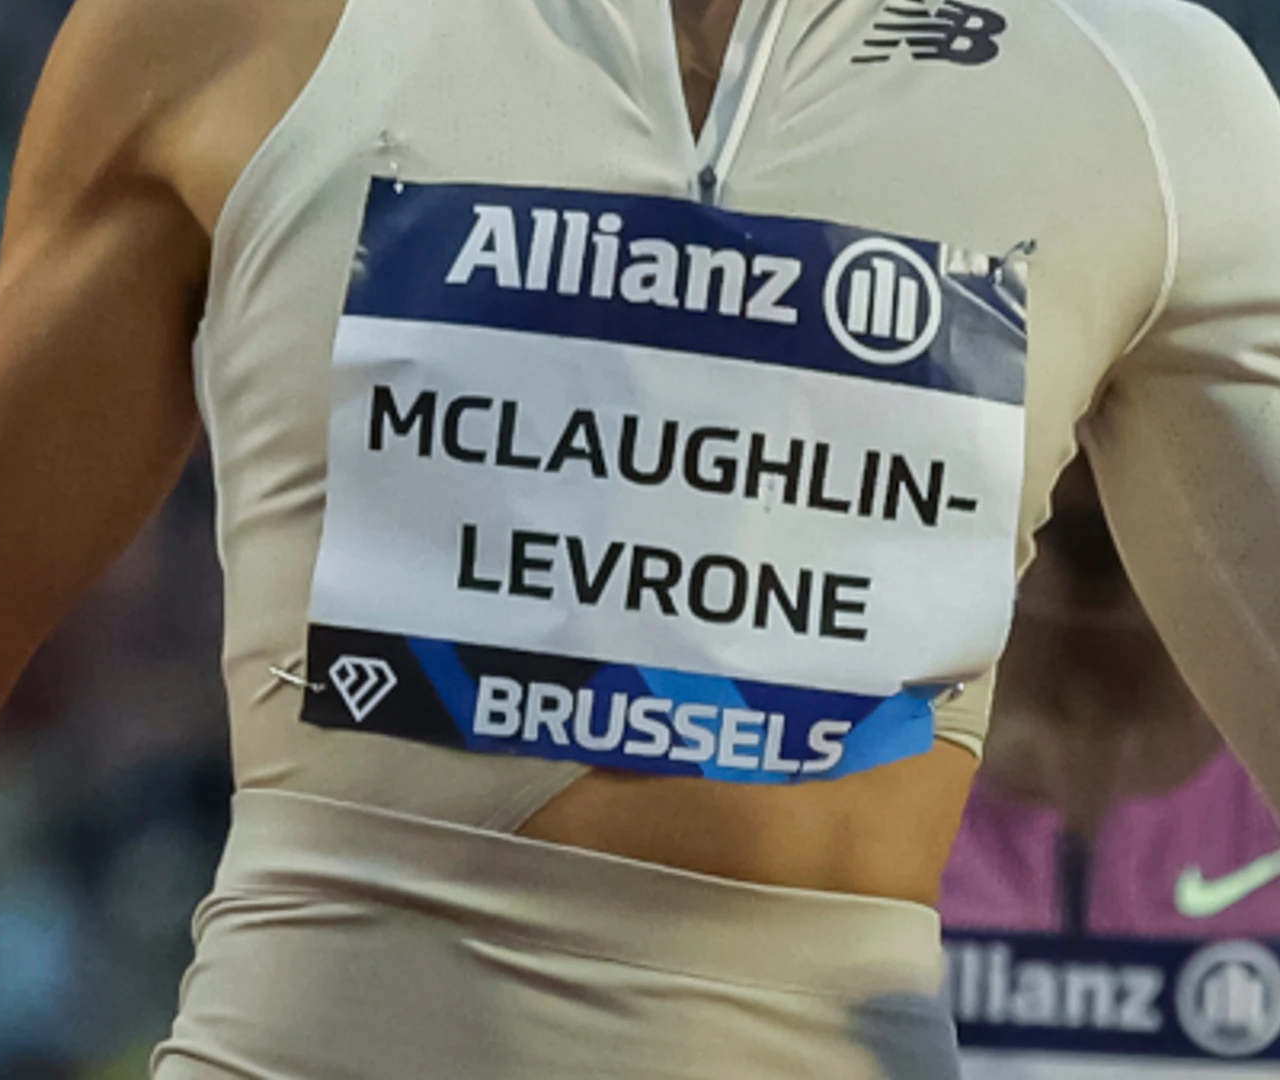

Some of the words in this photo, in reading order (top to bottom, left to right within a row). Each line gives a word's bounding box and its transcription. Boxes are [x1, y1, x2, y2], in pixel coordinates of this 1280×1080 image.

[445, 204, 803, 324] Allianz
[367, 384, 978, 527] MCLAUGHLIN-
[456, 523, 872, 642] LEVRONE
[472, 674, 852, 774] BRUSSELS
